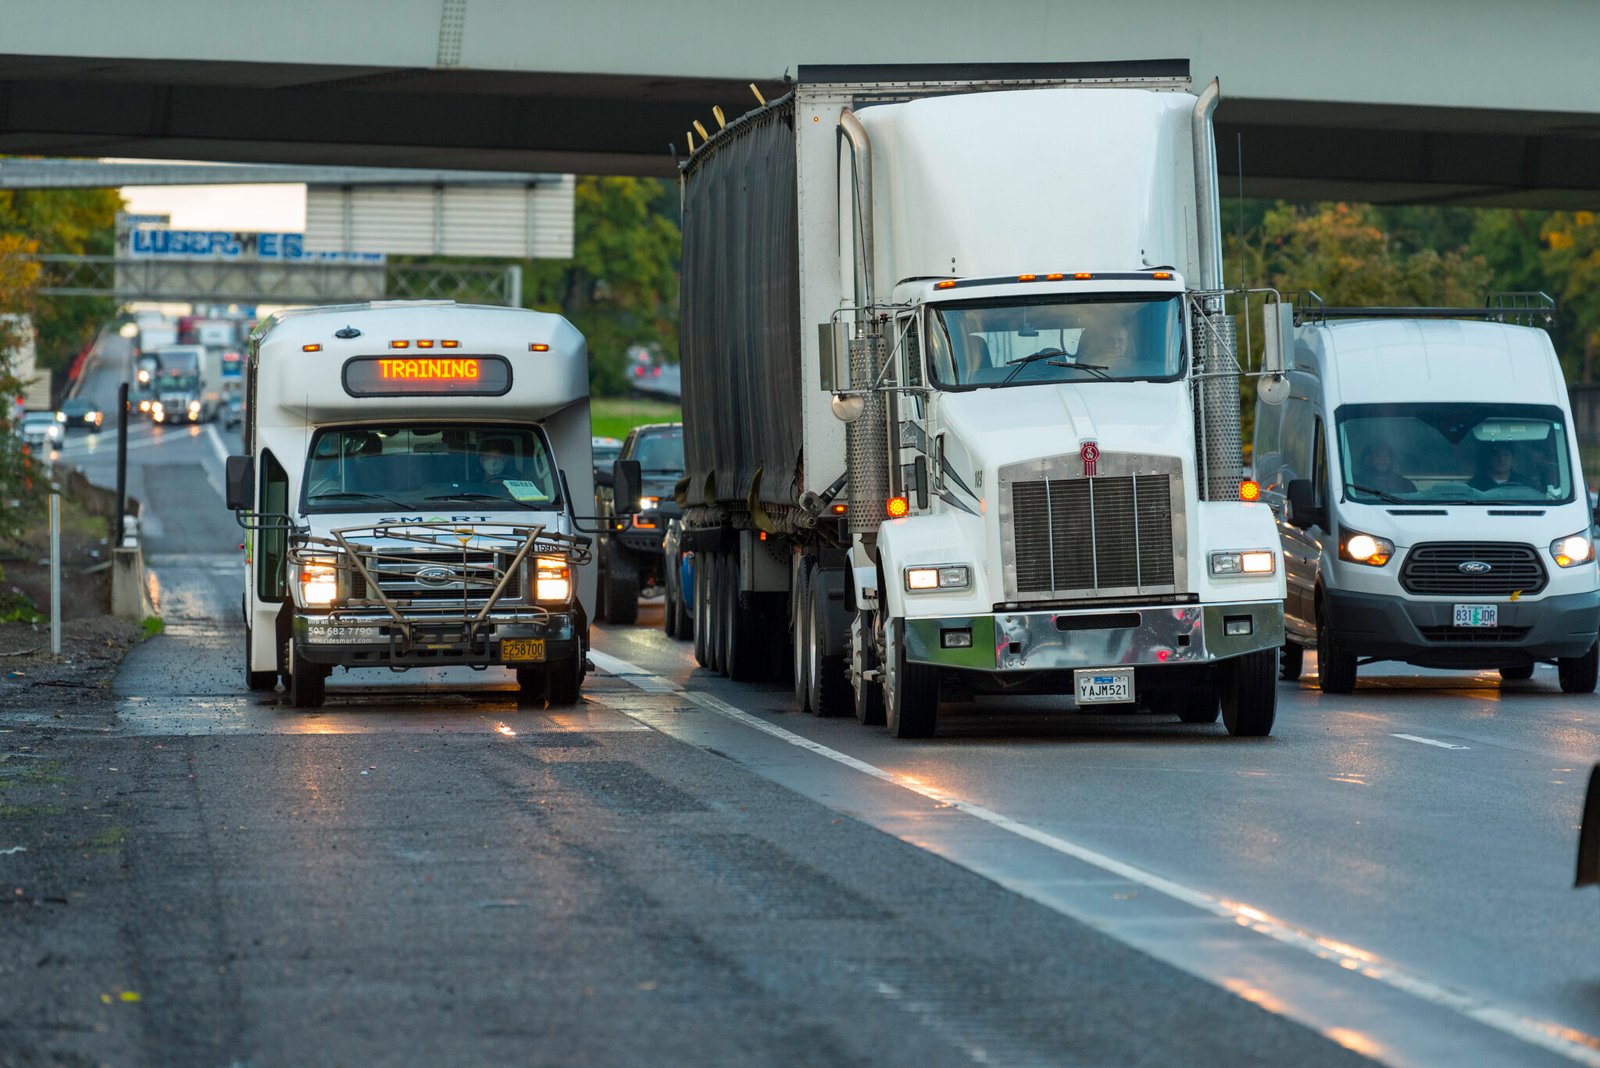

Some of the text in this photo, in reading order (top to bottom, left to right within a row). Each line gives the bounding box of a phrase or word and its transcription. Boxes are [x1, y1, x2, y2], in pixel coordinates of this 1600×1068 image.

[379, 359, 478, 378] TRAINING
[308, 627, 372, 635] 503 682 7790
[503, 643, 543, 656] E258700
